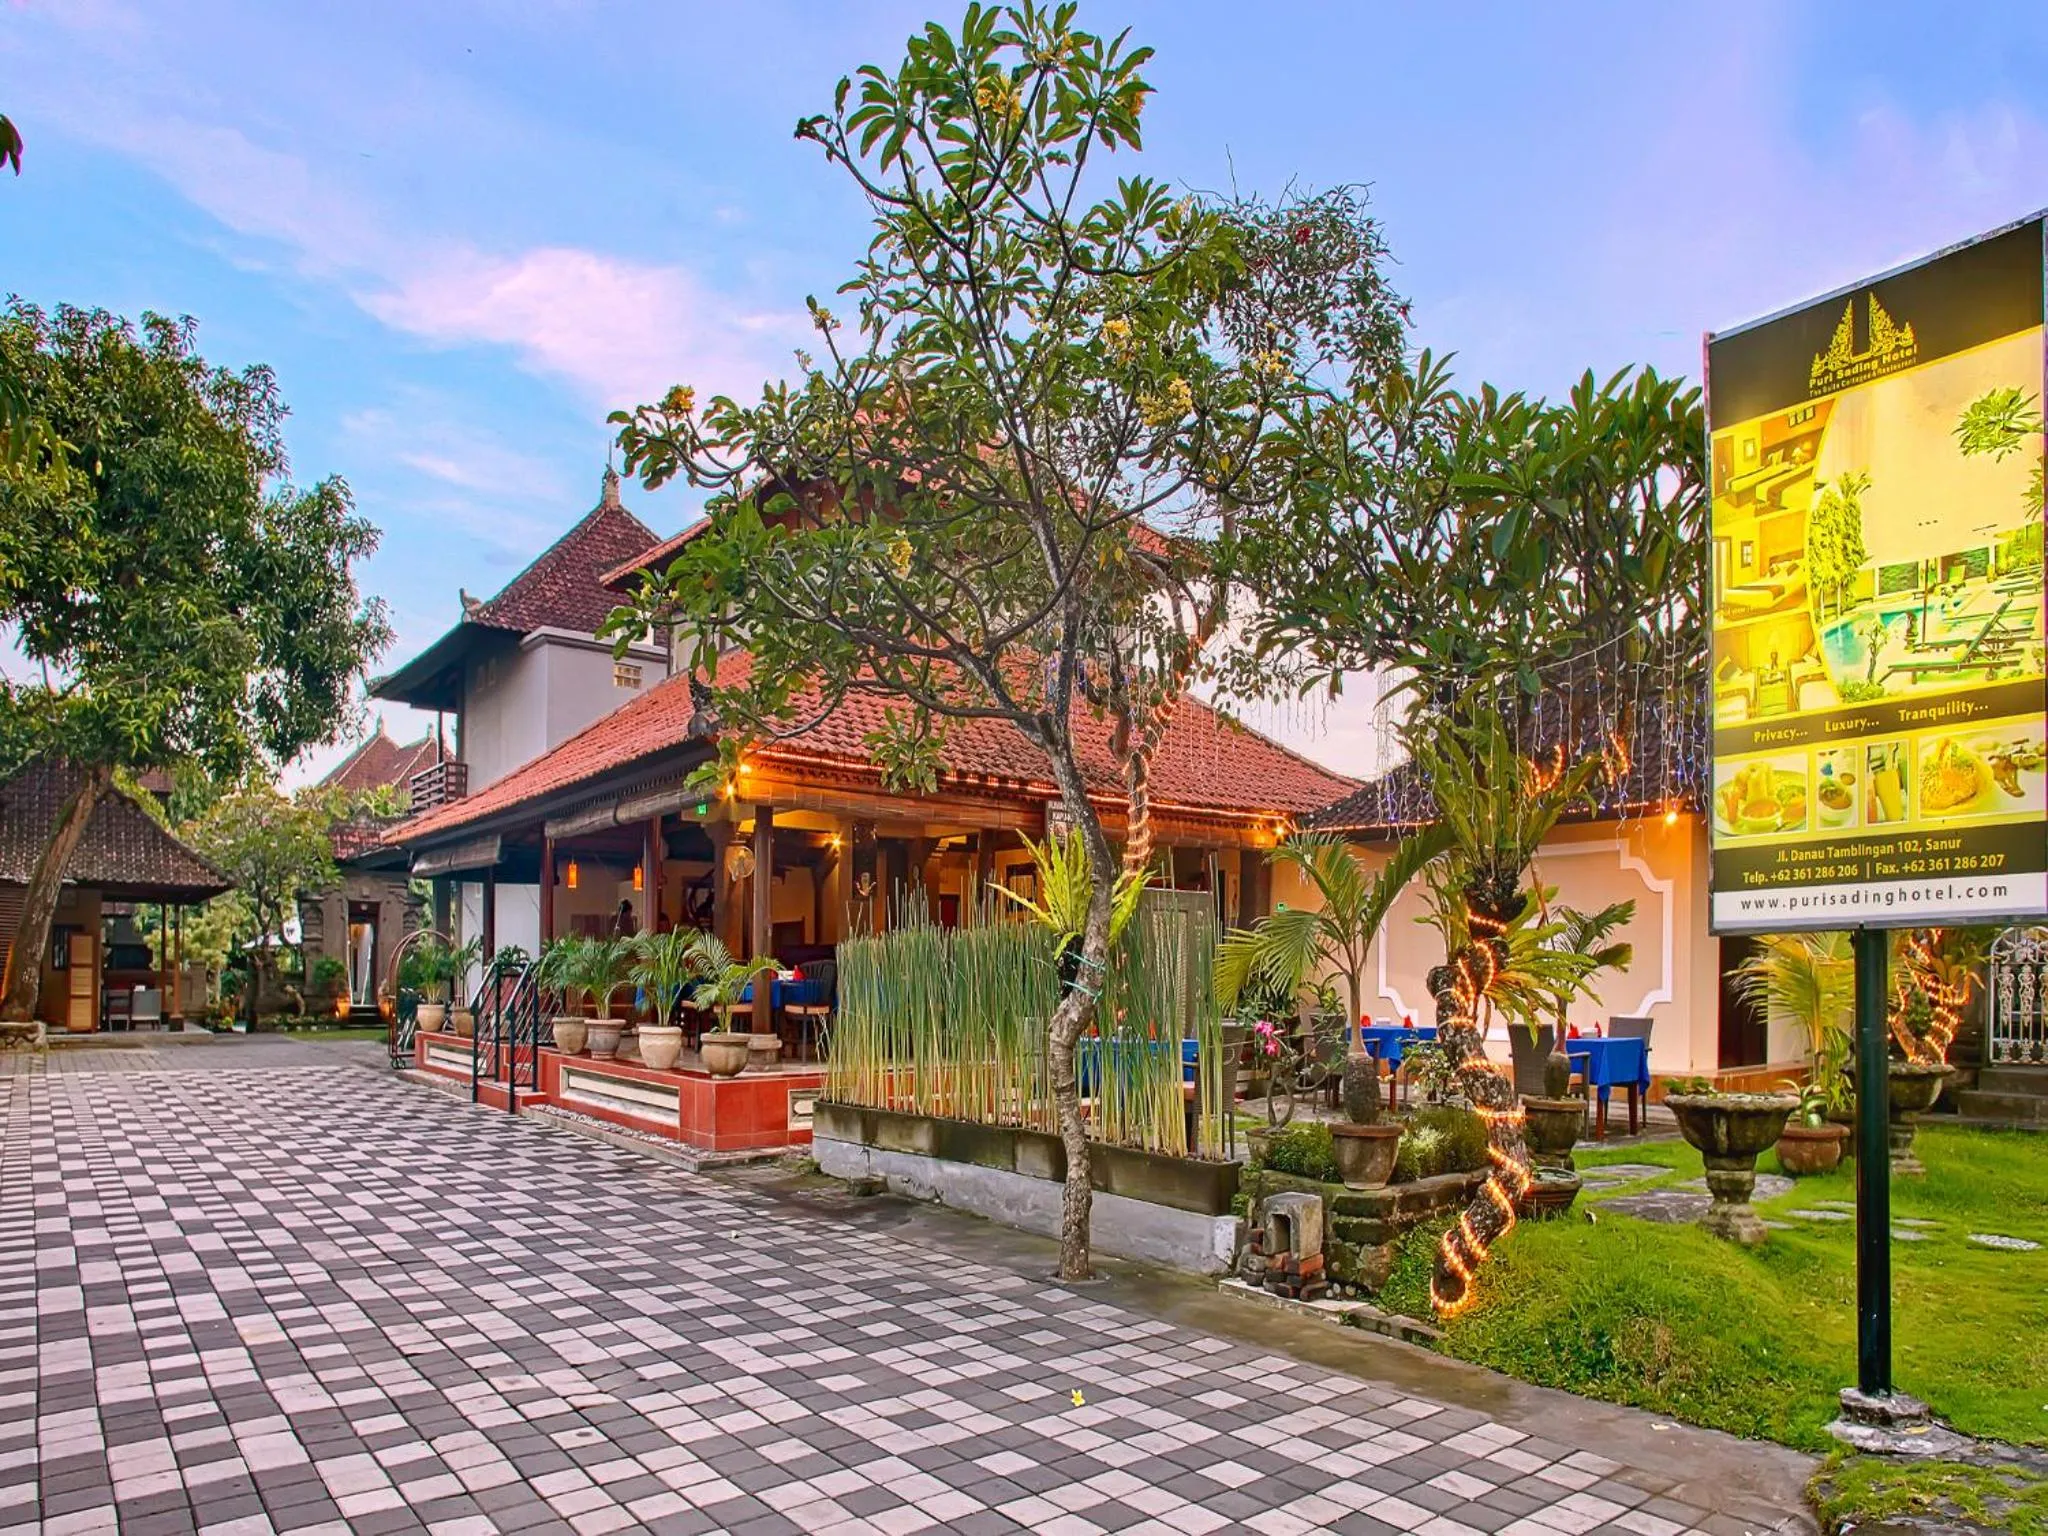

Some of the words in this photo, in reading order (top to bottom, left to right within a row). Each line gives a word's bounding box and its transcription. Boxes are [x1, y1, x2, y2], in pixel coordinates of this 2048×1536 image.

[1809, 372, 1832, 388] Puri
[1837, 360, 1878, 379] Sading
[1882, 344, 1917, 363] Hotel
[1791, 849, 1825, 861] Danau
[1827, 843, 1894, 859] Tamblingan
[1898, 841, 1922, 855] 102,
[1925, 838, 1962, 851] Sanur
[1743, 871, 1768, 884] Telp.
[1771, 869, 1790, 881] +62
[1793, 868, 1811, 880] 361
[1815, 866, 1835, 879] 286
[1837, 865, 1858, 877] 206
[1876, 861, 1899, 875] Fax.
[1902, 859, 1925, 873] +62
[1928, 858, 1950, 871] 361
[1954, 856, 1978, 870] 286
[1981, 854, 2004, 868] 207
[1741, 884, 2008, 910] www.purisadinghotel.com
